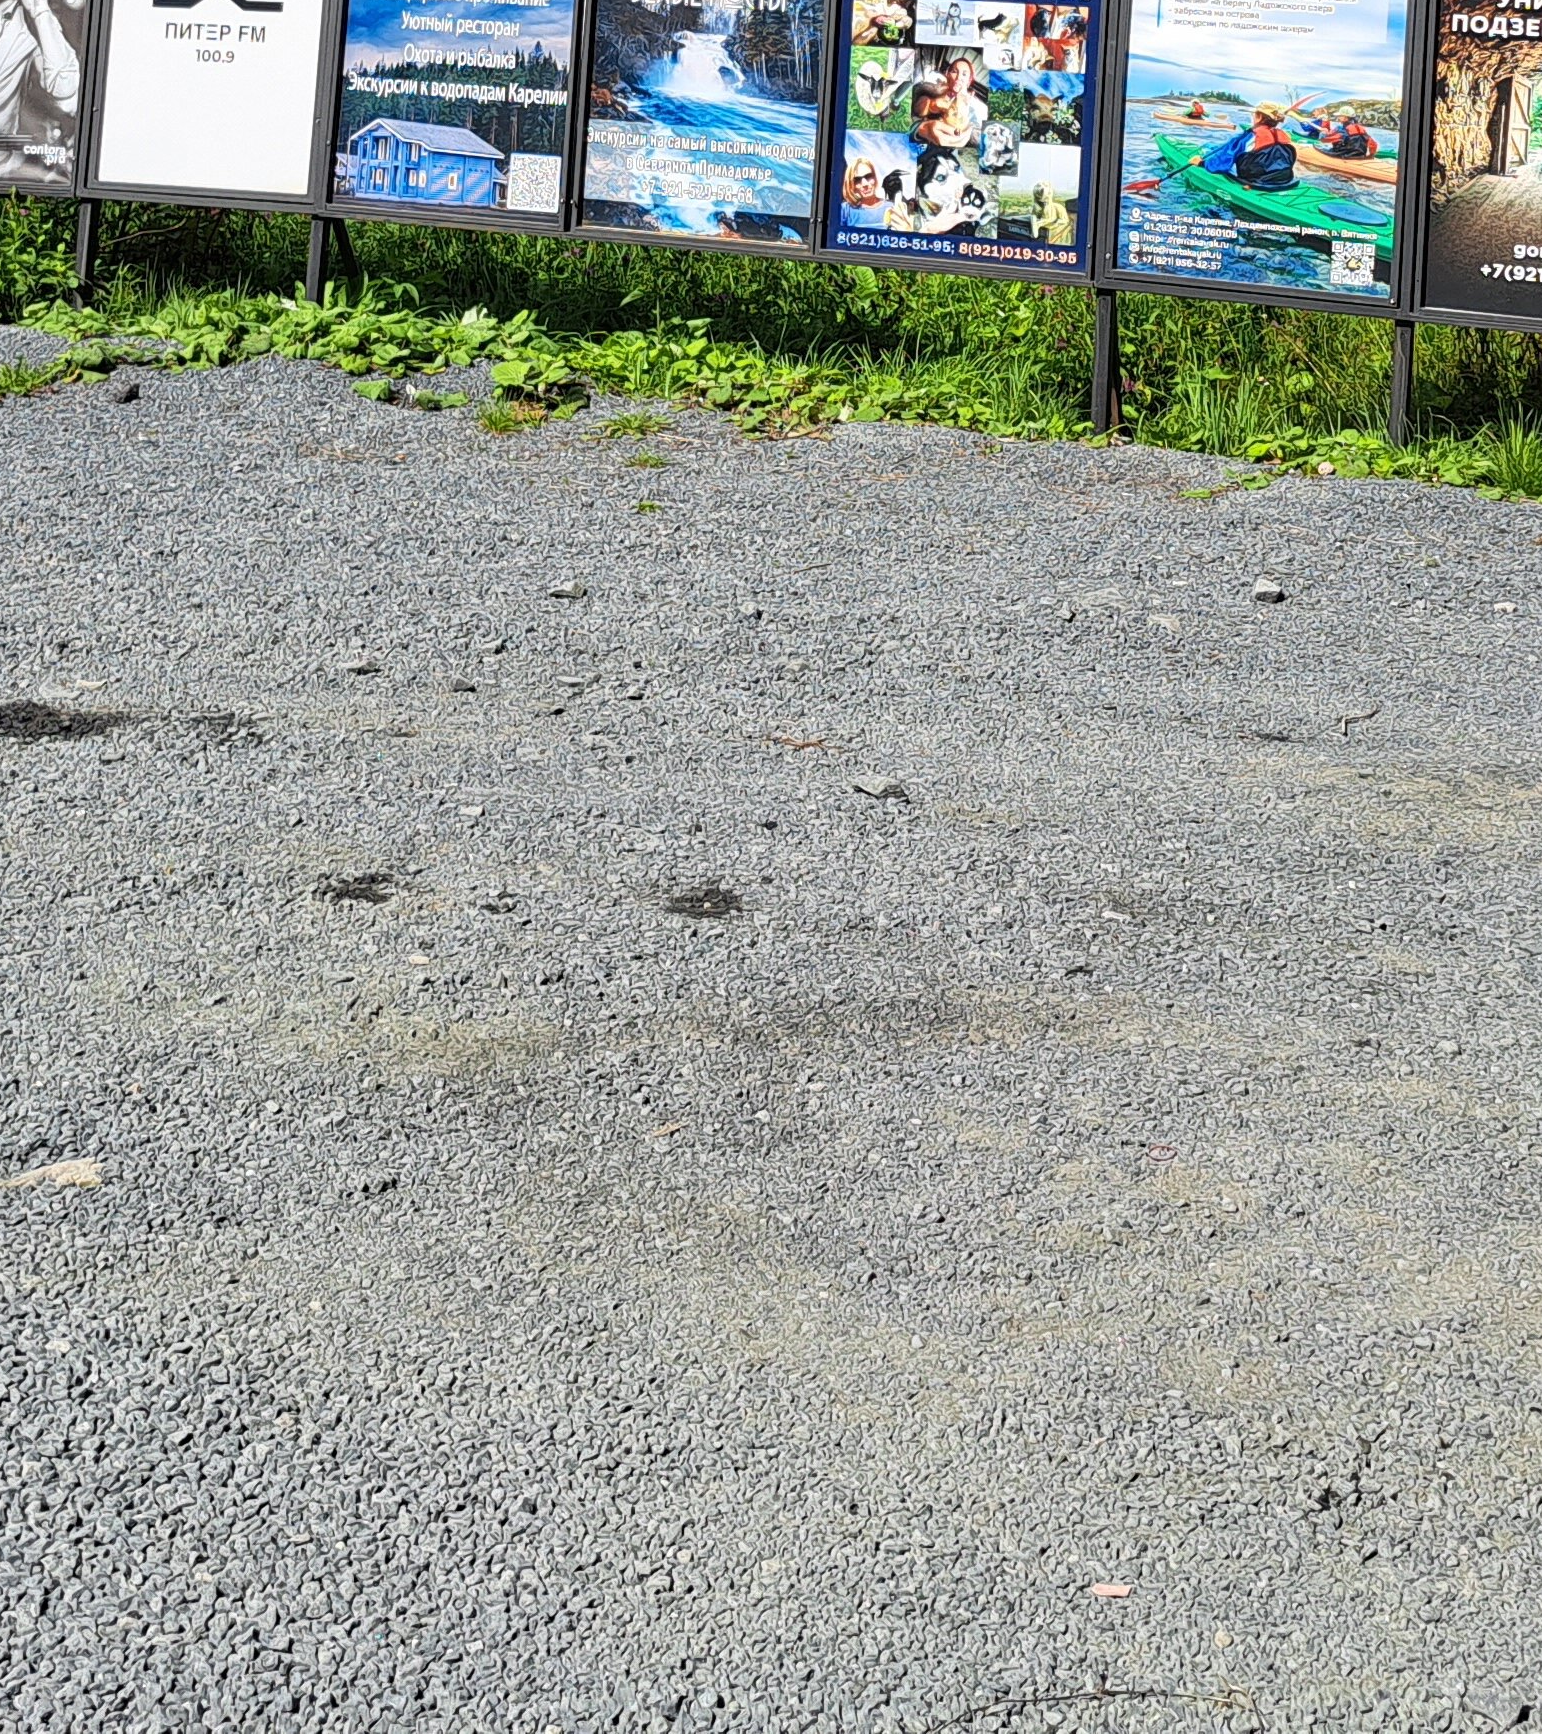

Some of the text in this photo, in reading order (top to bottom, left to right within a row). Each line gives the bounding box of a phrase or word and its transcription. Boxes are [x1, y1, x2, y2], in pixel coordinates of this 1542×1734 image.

[165, 22, 266, 43] ПИТЕР FM
[401, 10, 520, 39] Уютный ресторан
[195, 48, 235, 64] 100.9
[403, 43, 516, 70] Охота и рыбалка
[347, 72, 568, 109] Экскурсии к водопадам Карелии
[586, 126, 816, 163] Экскурсии на самый высокий водопад
[625, 154, 772, 181] в Северном Приладожье
